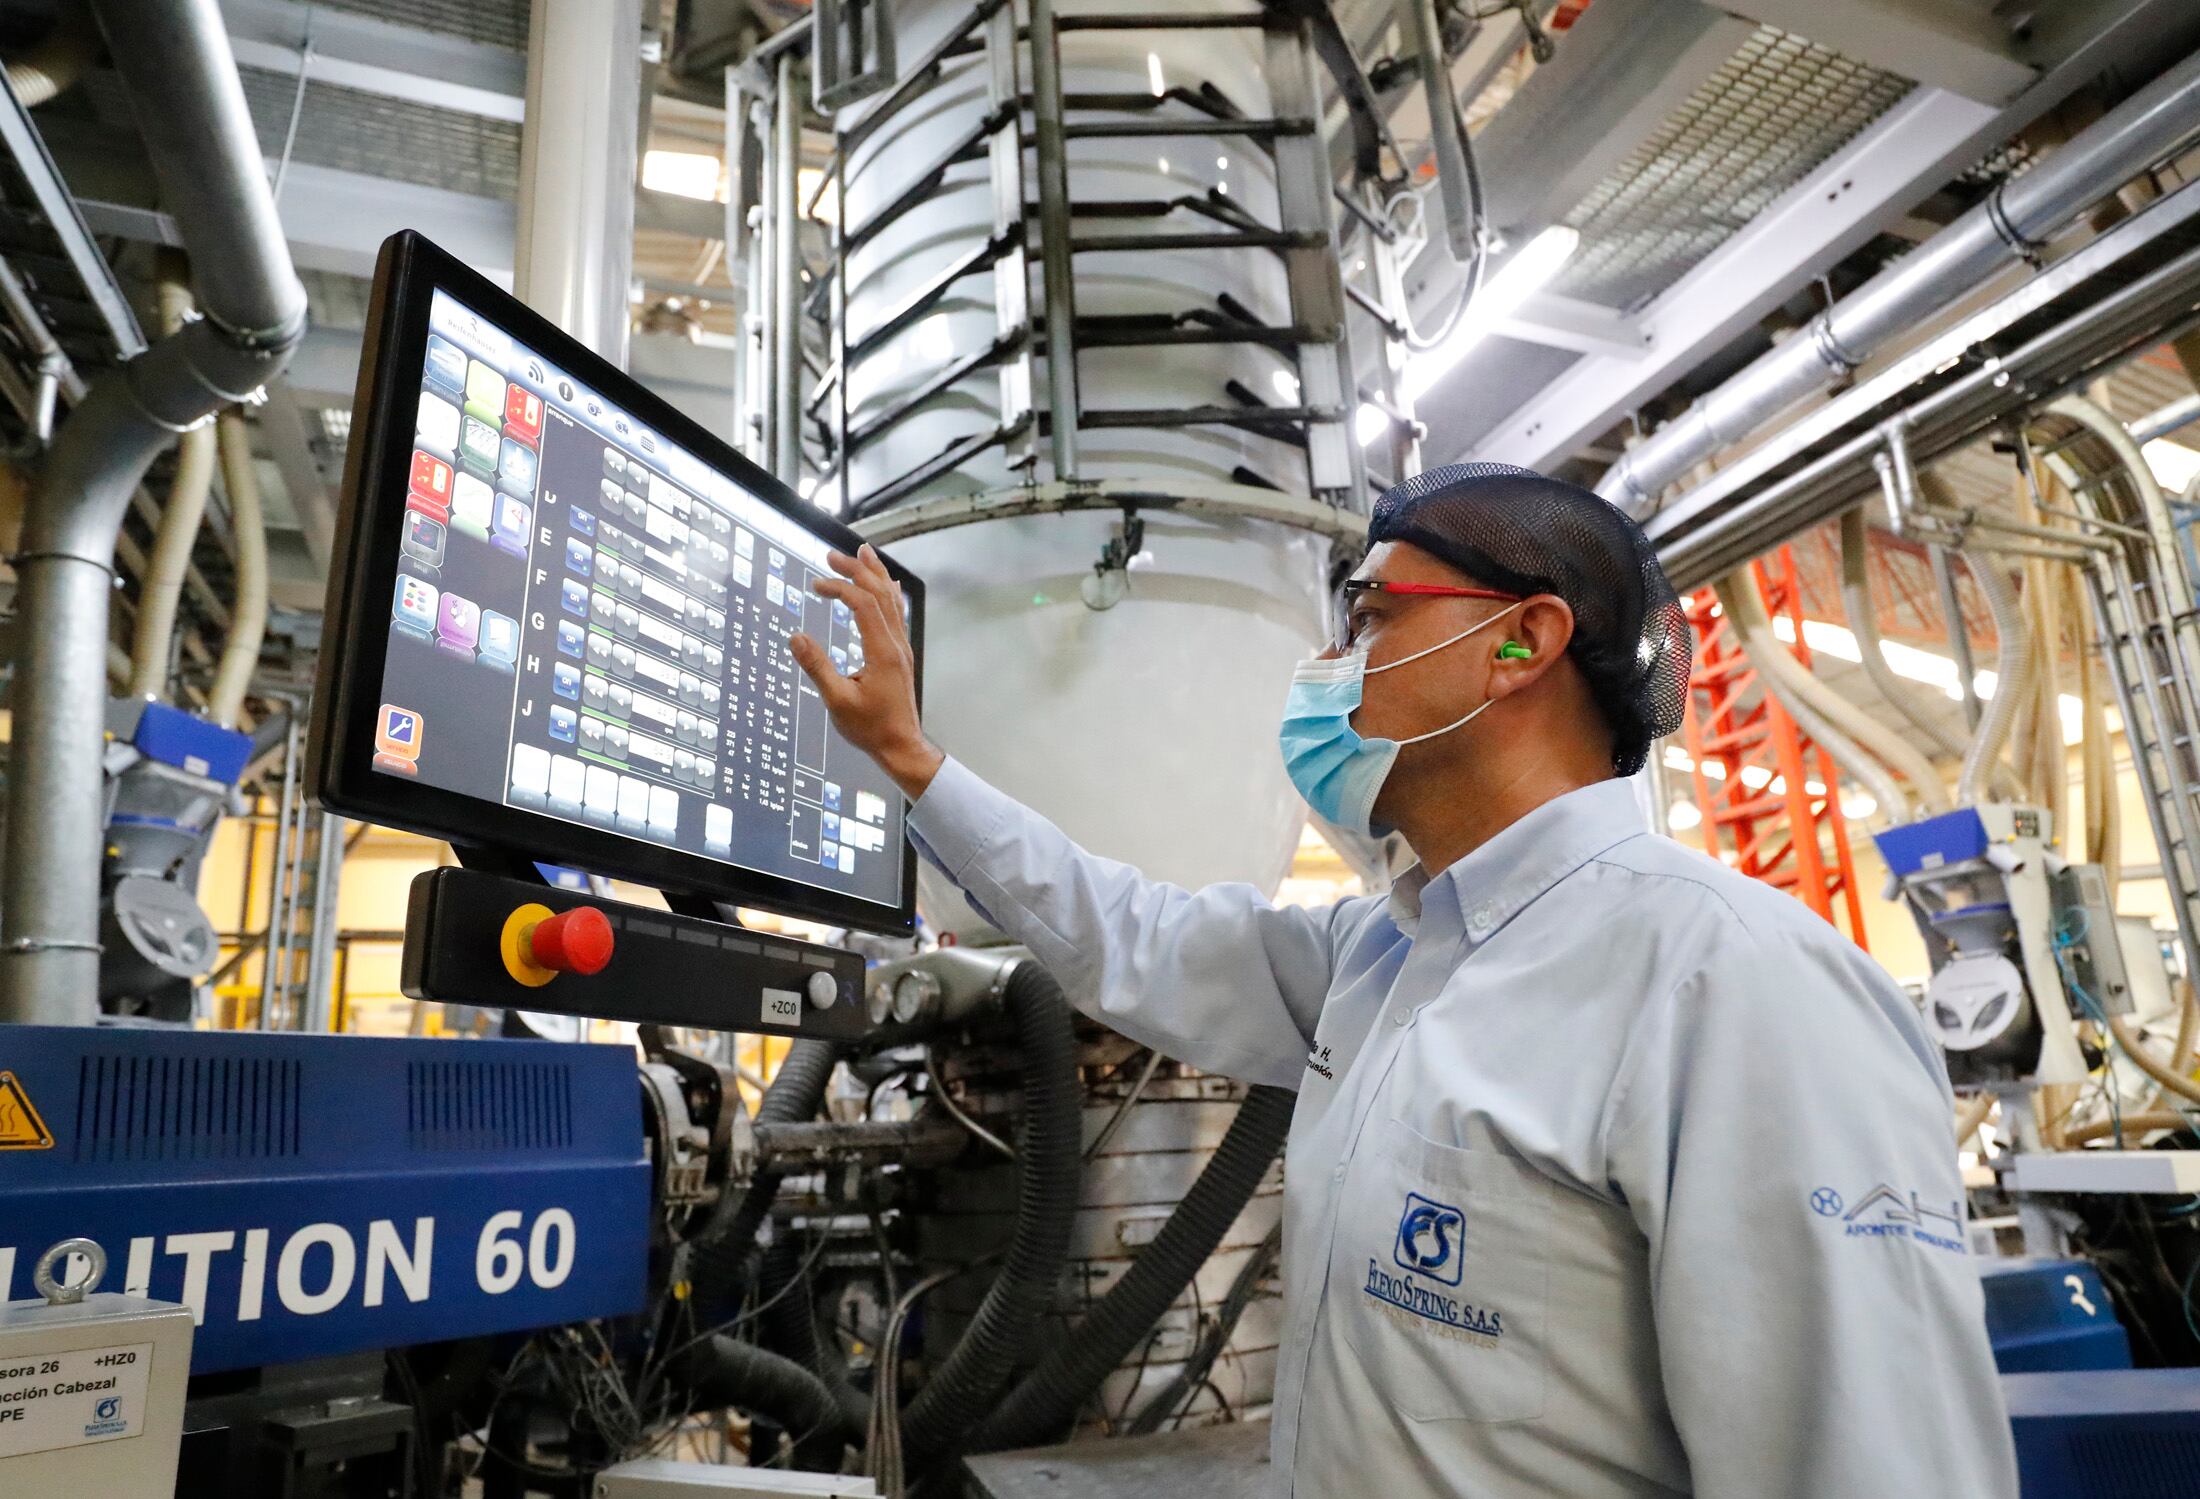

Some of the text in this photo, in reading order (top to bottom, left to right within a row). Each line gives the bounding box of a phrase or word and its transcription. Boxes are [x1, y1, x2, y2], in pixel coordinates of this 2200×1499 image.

[577, 511, 588, 523] on
[541, 527, 552, 545] E
[574, 551, 584, 563] on
[536, 569, 547, 584] F
[570, 592, 580, 603] on
[532, 612, 544, 630] G
[566, 633, 576, 644] on
[527, 655, 540, 673] H
[561, 675, 572, 687] on
[522, 700, 532, 716] J
[557, 718, 568, 730] on
[772, 1001, 796, 1015] +ZC0
[1305, 1058, 1333, 1080] rusión
[475, 1207, 575, 1294] 60
[1463, 1304, 1504, 1334] S.A.S.
[40, 1361, 60, 1374] 26
[94, 1352, 136, 1366] +HZ0
[53, 1376, 117, 1396] Cabezal
